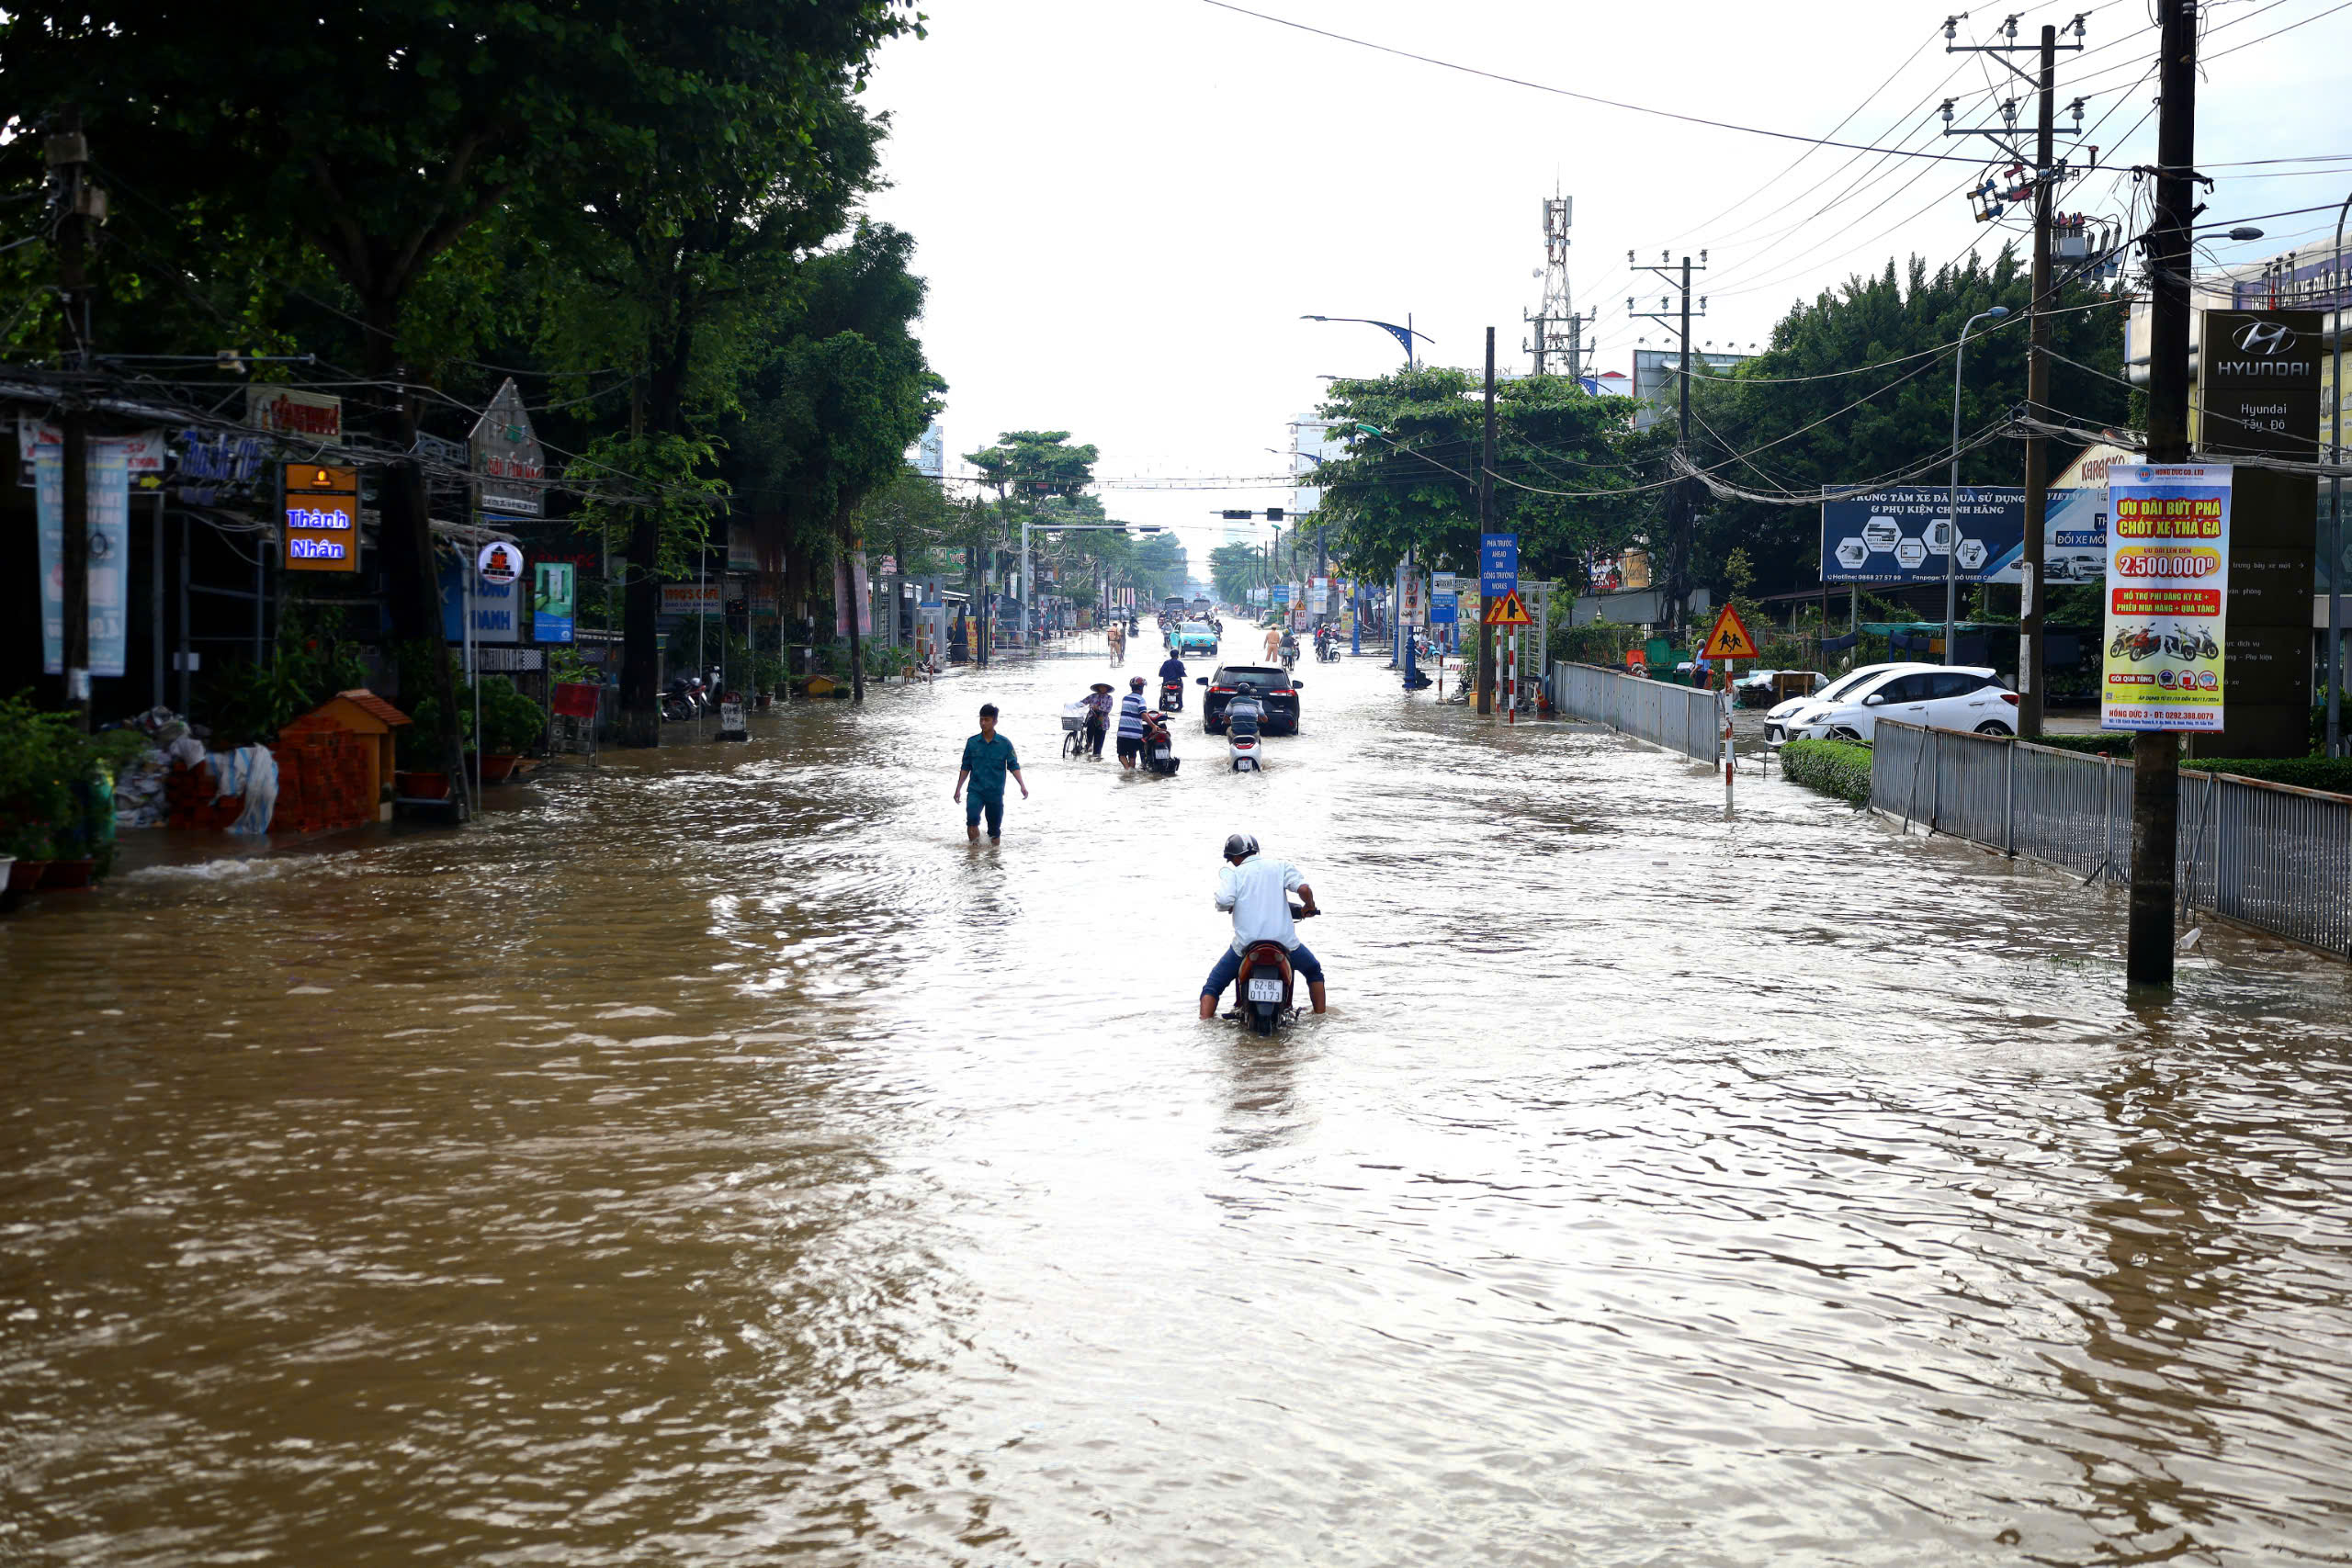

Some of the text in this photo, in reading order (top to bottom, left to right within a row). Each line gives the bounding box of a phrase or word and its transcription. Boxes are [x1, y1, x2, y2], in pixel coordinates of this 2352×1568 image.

[2328, 268, 2348, 294] QA
[2218, 361, 2310, 377] HYUNDAI
[2241, 403, 2287, 417] Hyundai
[2242, 419, 2285, 433] Tây Đô
[2171, 468, 2183, 477] DUC
[1890, 492, 1915, 502] TÂM
[1916, 493, 1931, 502] XE
[1933, 492, 1949, 502] ĐÃ
[1977, 491, 1993, 502] SỬ
[1995, 494, 2026, 504] DỤNG
[1871, 503, 2005, 515] & PHỤ KIỆN CHNH HÃNG
[2119, 498, 2221, 515] ƯU ĐÃI BỨT PHÁ
[286, 508, 352, 529] Thành
[2119, 517, 2221, 535] CHỐT XE THẢ GA
[2057, 532, 2074, 545] ĐỔI
[2075, 535, 2088, 545] XE
[290, 538, 345, 559] Nhân
[1492, 550, 1507, 558] AHEAD
[1912, 574, 1941, 582] Fanpage:
[2193, 592, 2203, 602] XE
[2138, 604, 2153, 613] MUA
[2109, 708, 2127, 718] HỒNG
[2128, 709, 2143, 719] ĐỨC
[2143, 710, 2149, 719] 3
[1250, 990, 1280, 1001] 011.73
